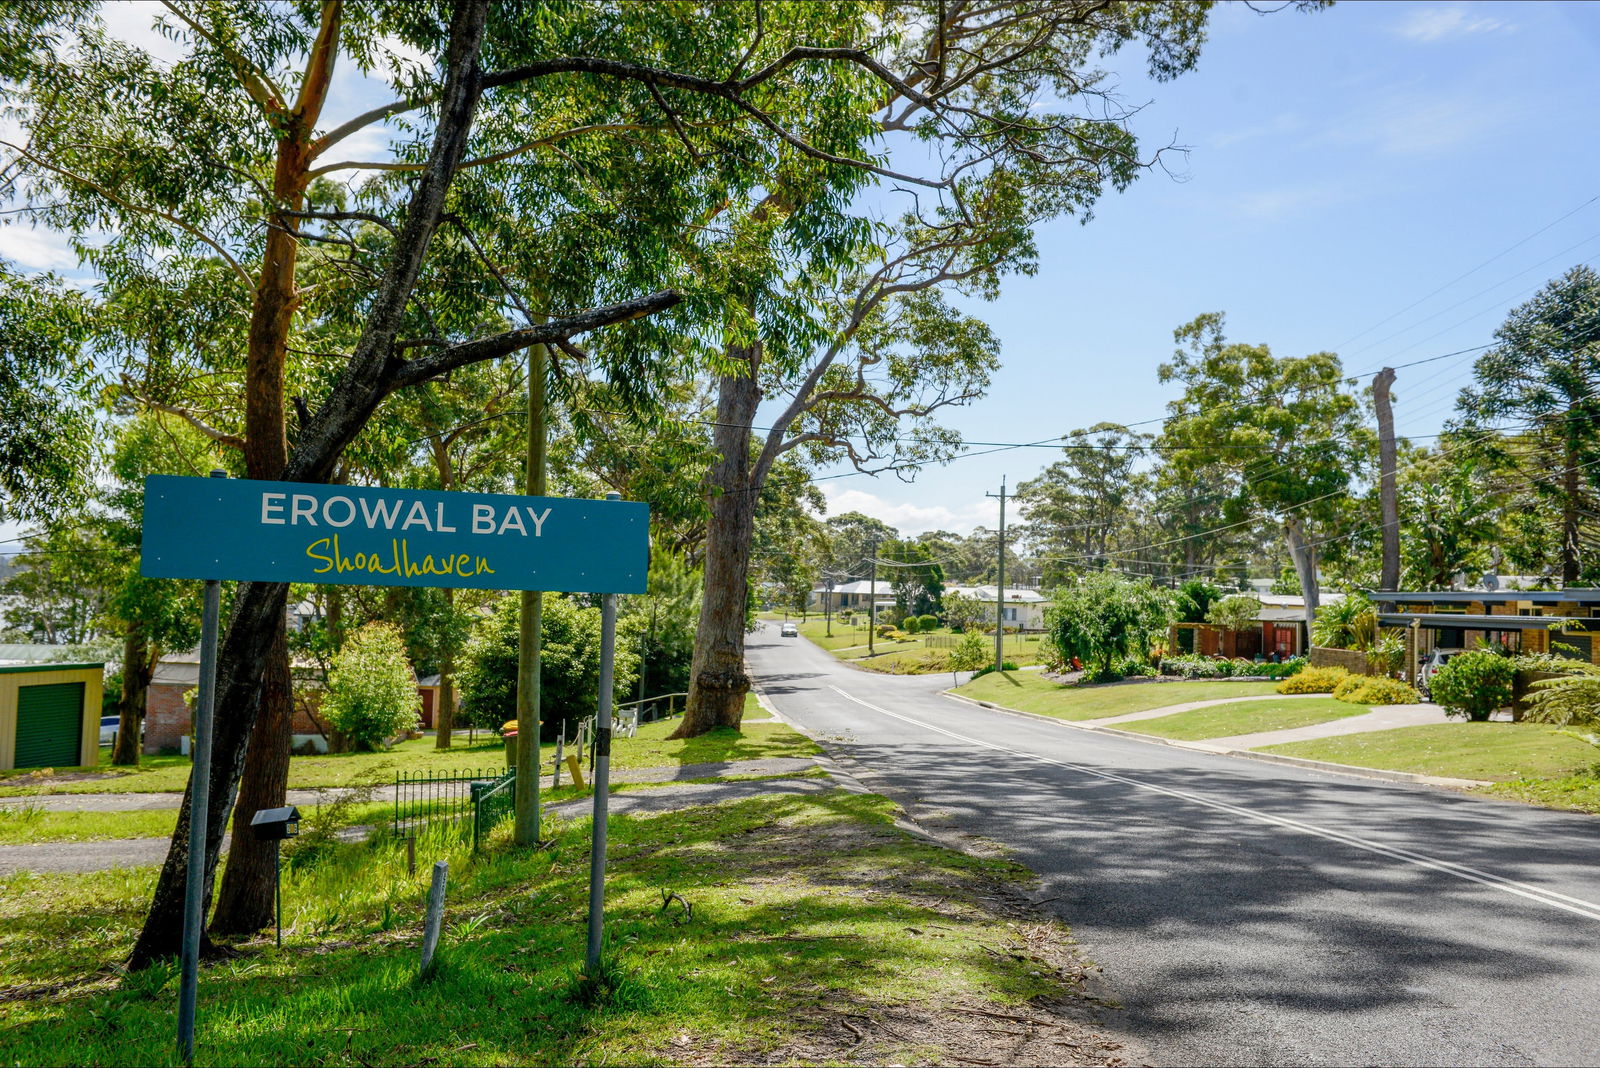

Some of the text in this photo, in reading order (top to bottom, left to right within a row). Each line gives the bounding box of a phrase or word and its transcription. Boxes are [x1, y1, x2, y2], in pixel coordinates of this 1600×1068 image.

[261, 492, 552, 537] EROWAL BAY
[306, 533, 494, 577] Shoalhaven
